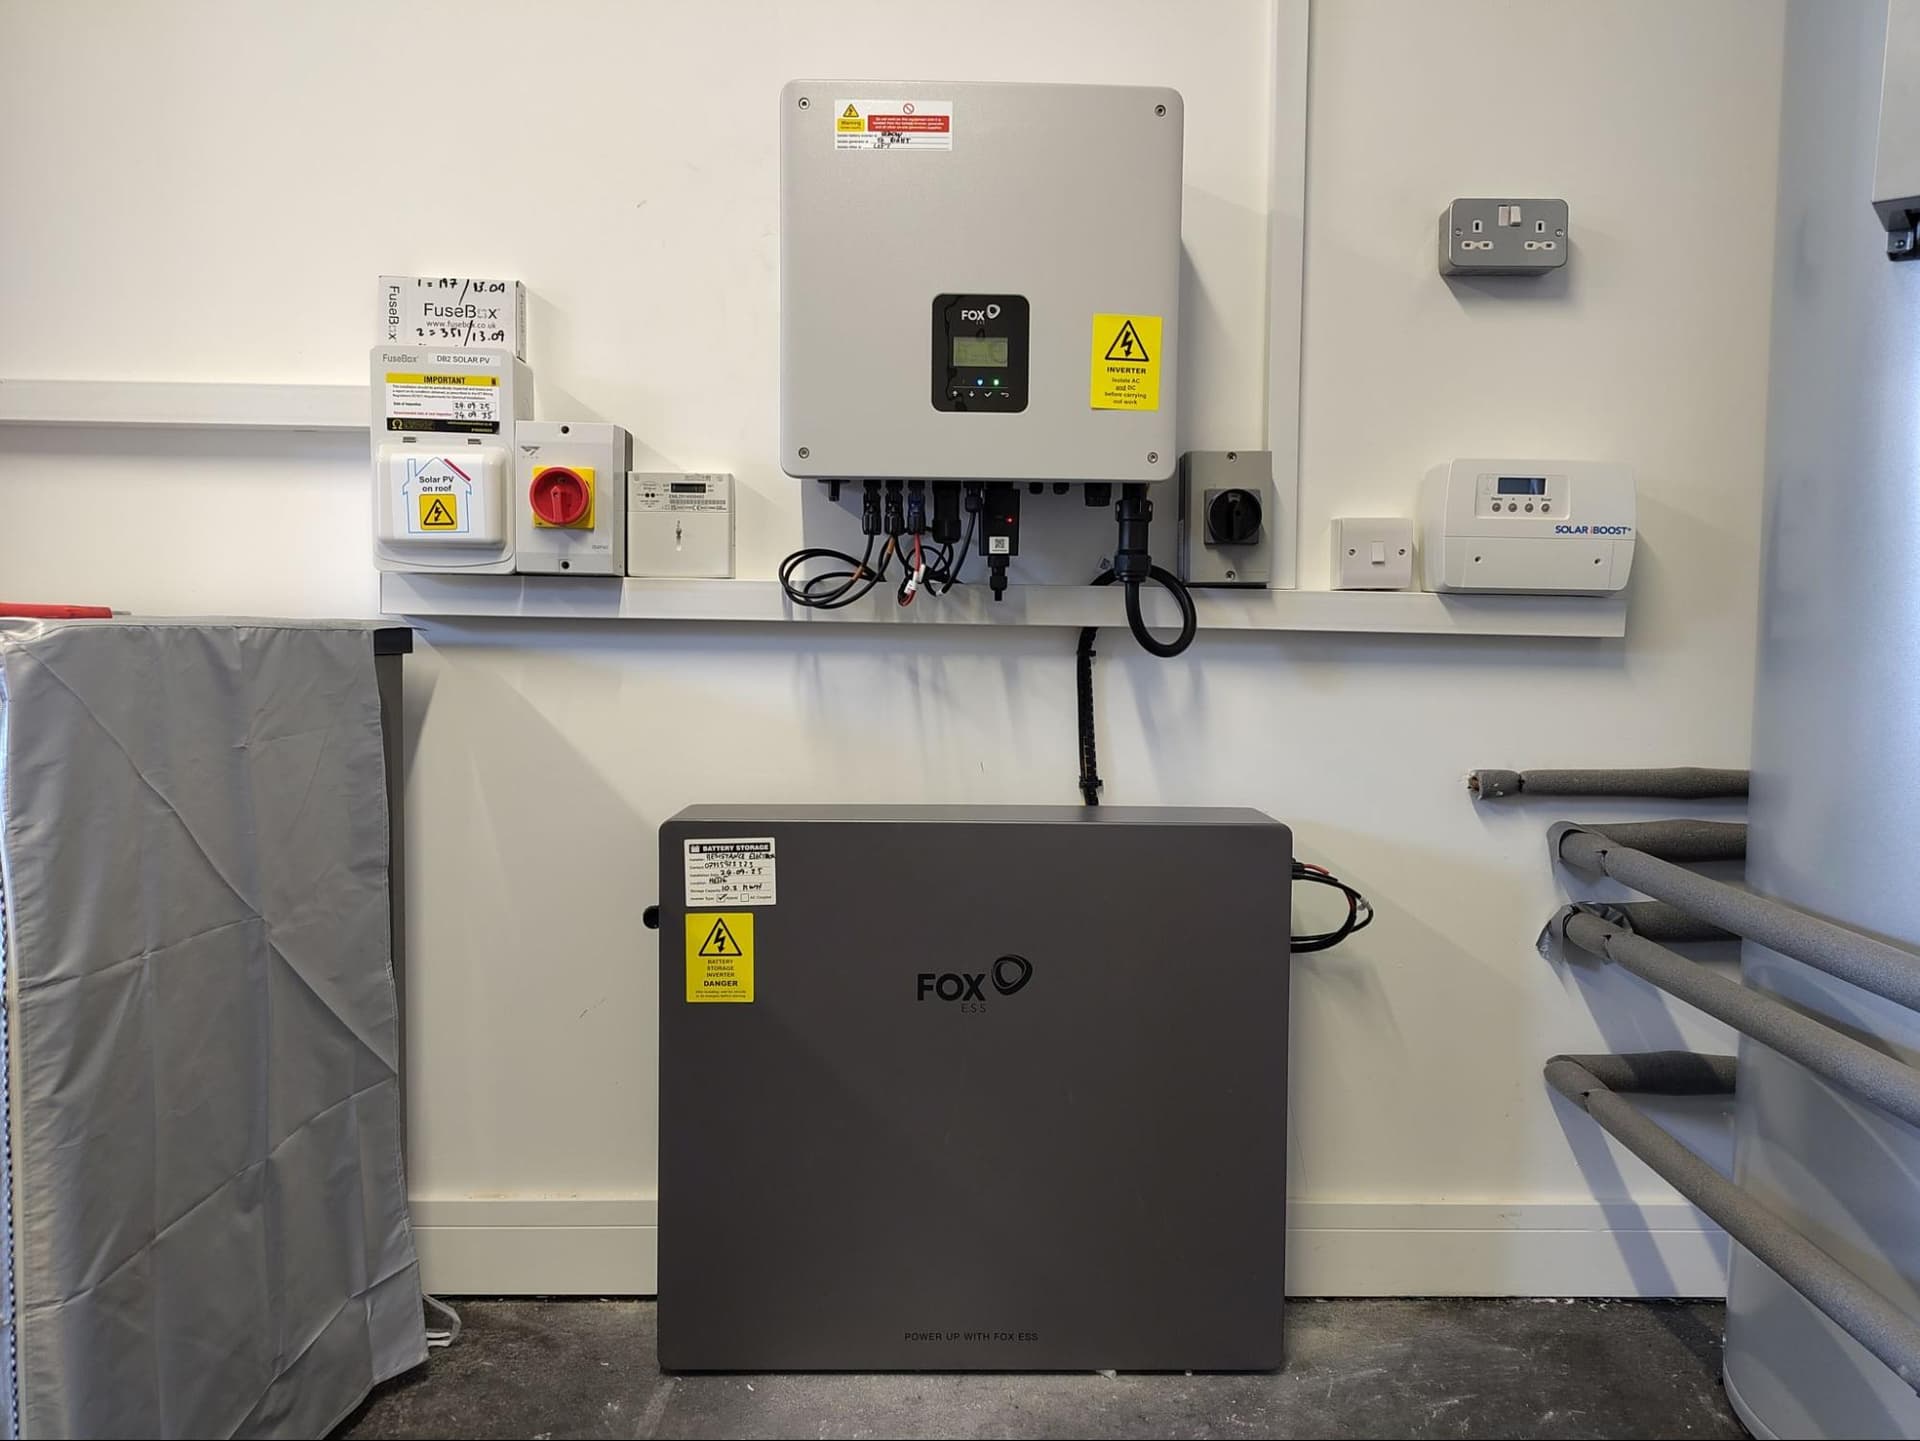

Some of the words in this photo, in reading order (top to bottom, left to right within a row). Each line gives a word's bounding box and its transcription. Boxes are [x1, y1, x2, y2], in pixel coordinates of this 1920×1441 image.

[424, 302, 498, 320] FuseBox
[961, 310, 985, 321] FOX
[382, 354, 417, 364] FuseBox
[436, 355, 451, 363] DB2
[452, 356, 478, 364] SOLAR
[1106, 366, 1146, 374] INVERTER
[424, 376, 466, 385] IMPORTANT
[419, 476, 441, 484] Solar
[442, 476, 454, 484] PV
[435, 484, 452, 492] roof
[1555, 525, 1588, 534] SOLAR
[917, 973, 986, 1001] FOX
[961, 1003, 986, 1013] ESS
[904, 1332, 942, 1340] POWER
[946, 1332, 960, 1340] UP
[964, 1332, 990, 1340] WITH
[994, 1332, 1014, 1340] FOX
[1018, 1332, 1039, 1340] ESS
